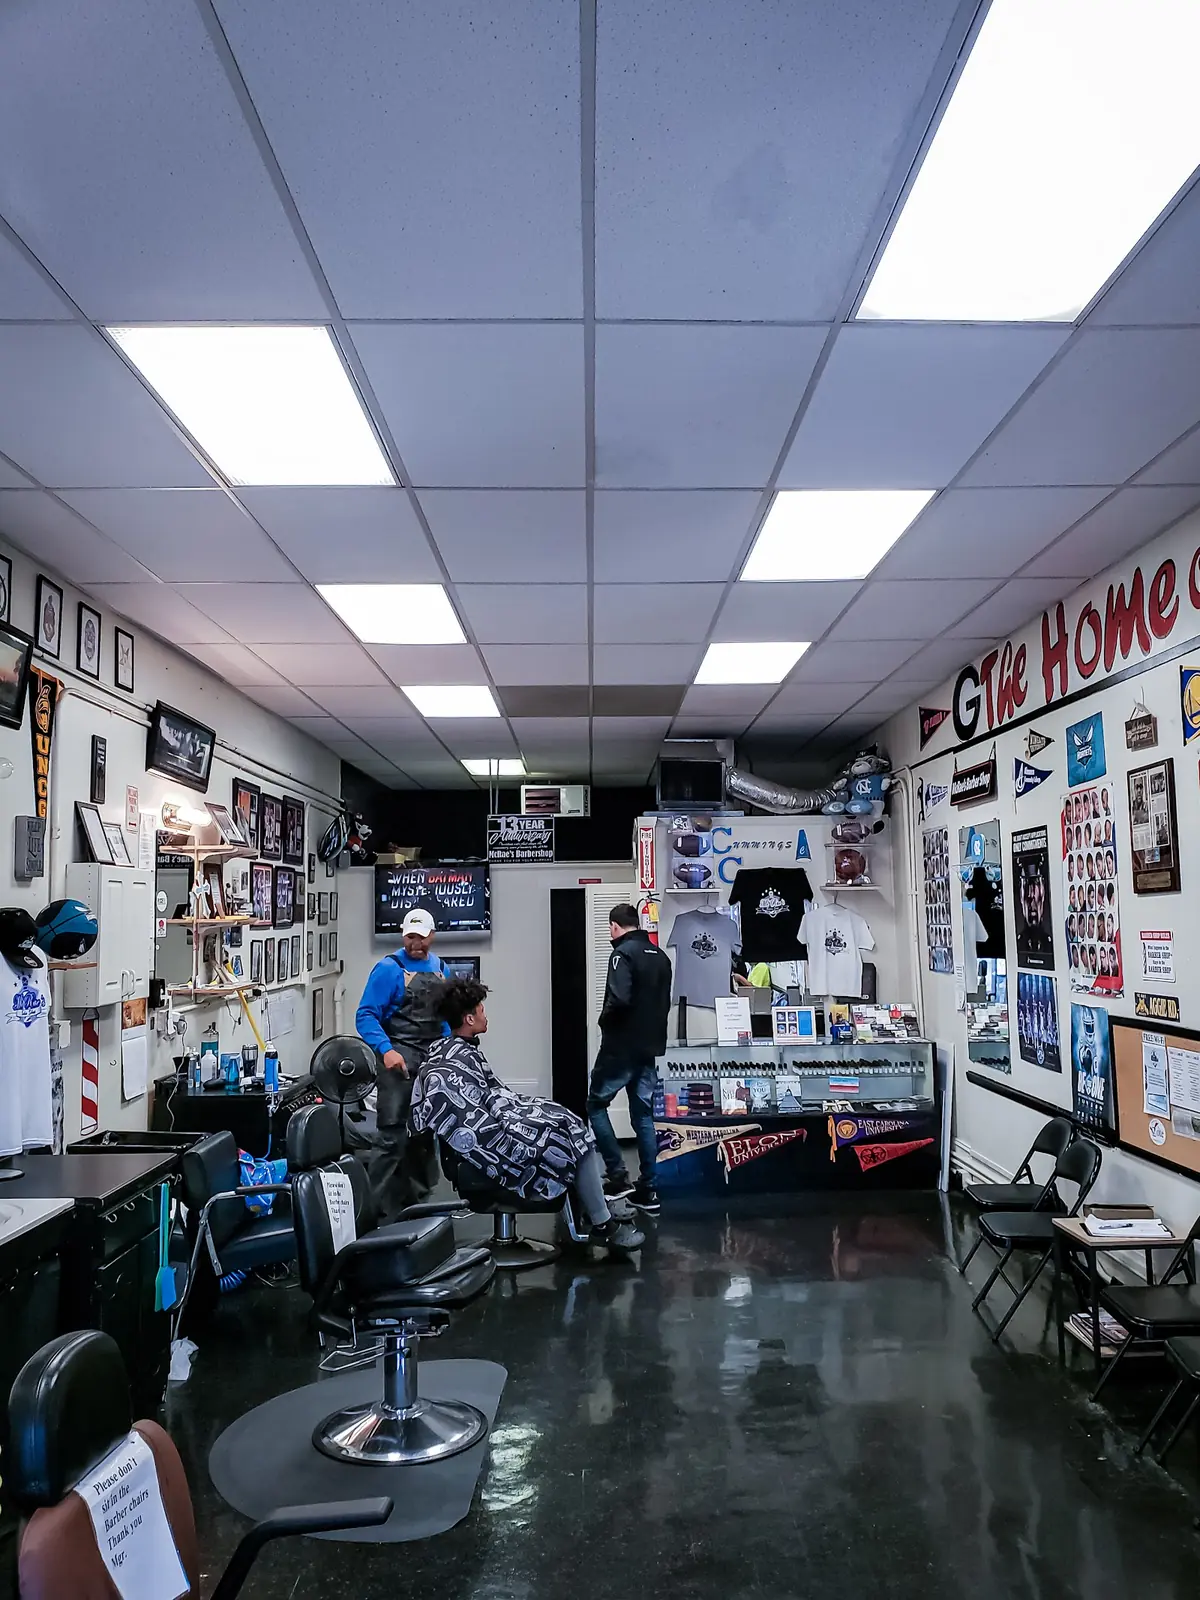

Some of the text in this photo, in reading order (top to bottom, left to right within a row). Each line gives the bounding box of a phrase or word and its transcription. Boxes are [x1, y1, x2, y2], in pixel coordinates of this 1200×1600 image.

[980, 640, 1029, 731] The
[1041, 558, 1180, 705] Home
[497, 816, 545, 834] 13 YEAR
[857, 1119, 909, 1129] EAST CAROLINA
[865, 1125, 903, 1136] UNIVERSITY
[727, 1129, 797, 1158] ELON
[93, 1457, 138, 1496] Please don't
[101, 1483, 130, 1515] sit in the
[104, 1488, 149, 1533] Barber chairs
[107, 1514, 143, 1552] Thank you
[111, 1549, 128, 1569] Mgr.
